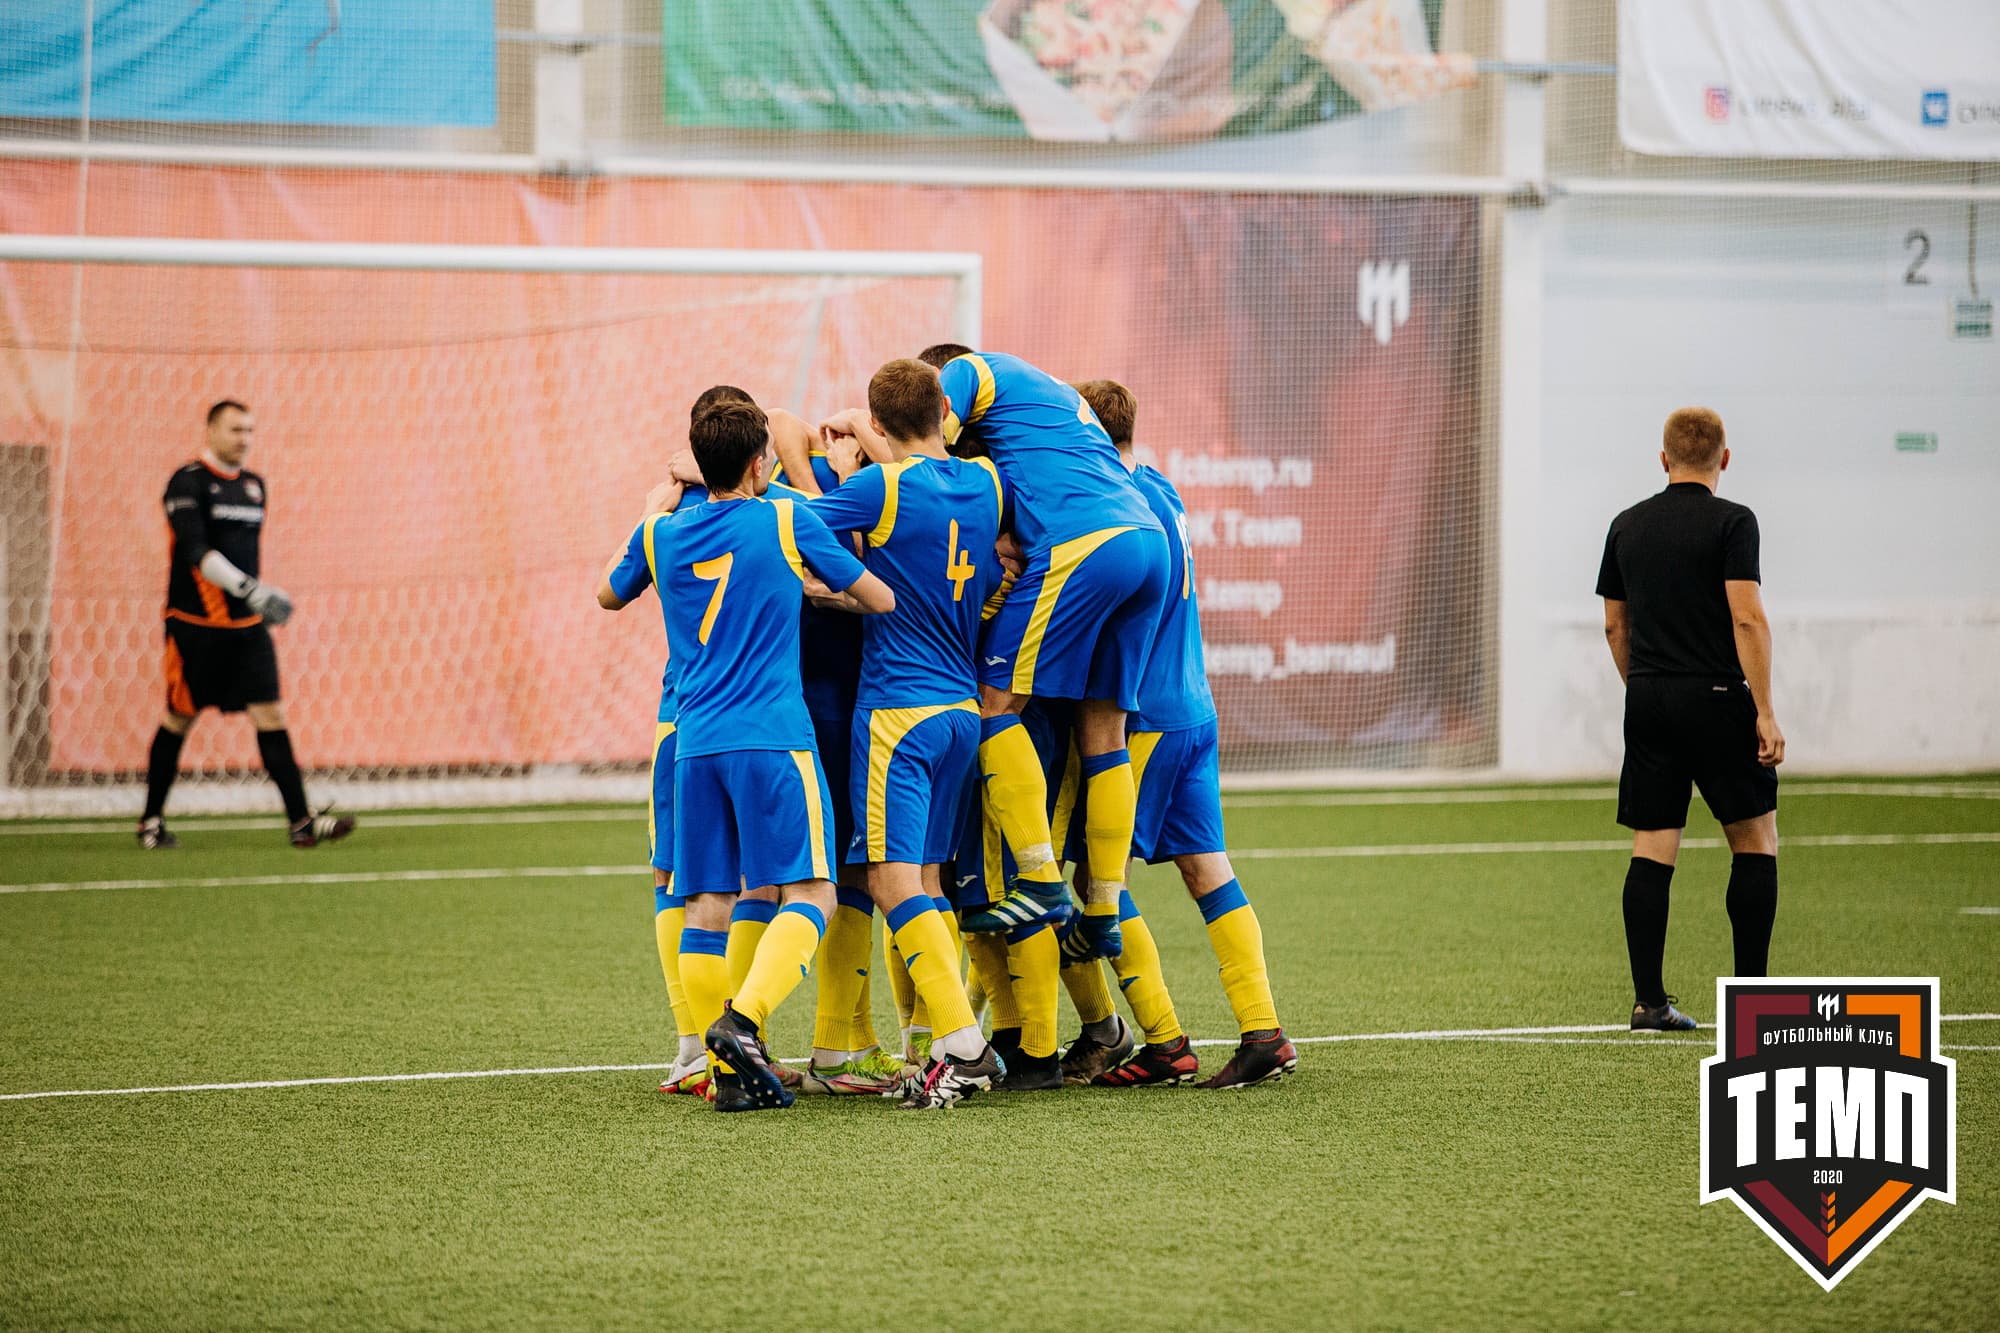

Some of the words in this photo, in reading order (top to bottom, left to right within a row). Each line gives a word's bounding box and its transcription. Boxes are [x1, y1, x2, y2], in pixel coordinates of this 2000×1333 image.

[1904, 229, 1931, 286] 2
[947, 518, 976, 602] 4
[692, 551, 734, 647] 7
[1198, 577, 1283, 618] temp
